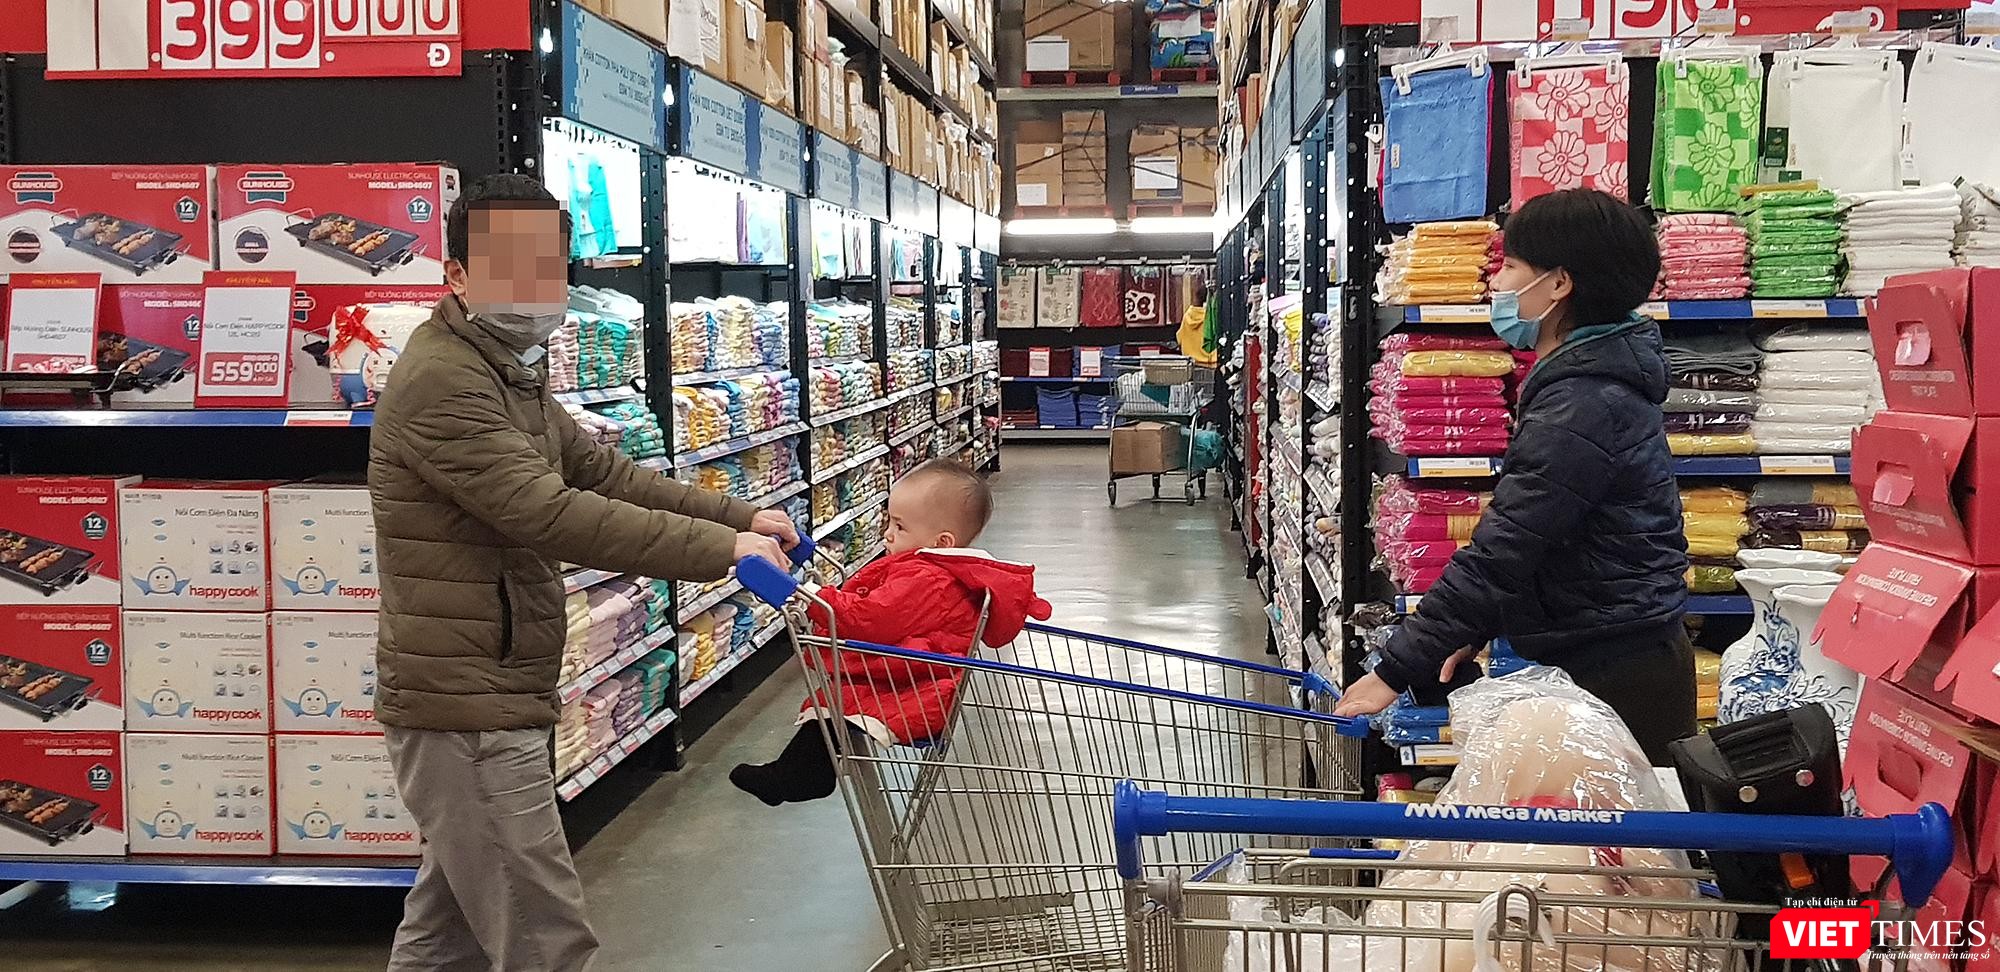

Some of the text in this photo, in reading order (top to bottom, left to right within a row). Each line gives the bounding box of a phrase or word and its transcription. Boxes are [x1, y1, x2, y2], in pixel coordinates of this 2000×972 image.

[427, 43, 451, 68] Đ
[242, 181, 290, 189] SUNHOUSE
[180, 200, 193, 213] 12
[412, 200, 426, 213] 12
[186, 319, 200, 331] 12
[211, 361, 253, 382] 559
[254, 362, 278, 373] 000
[86, 517, 102, 529] 12
[89, 643, 106, 655] 12
[91, 769, 107, 781] 12
